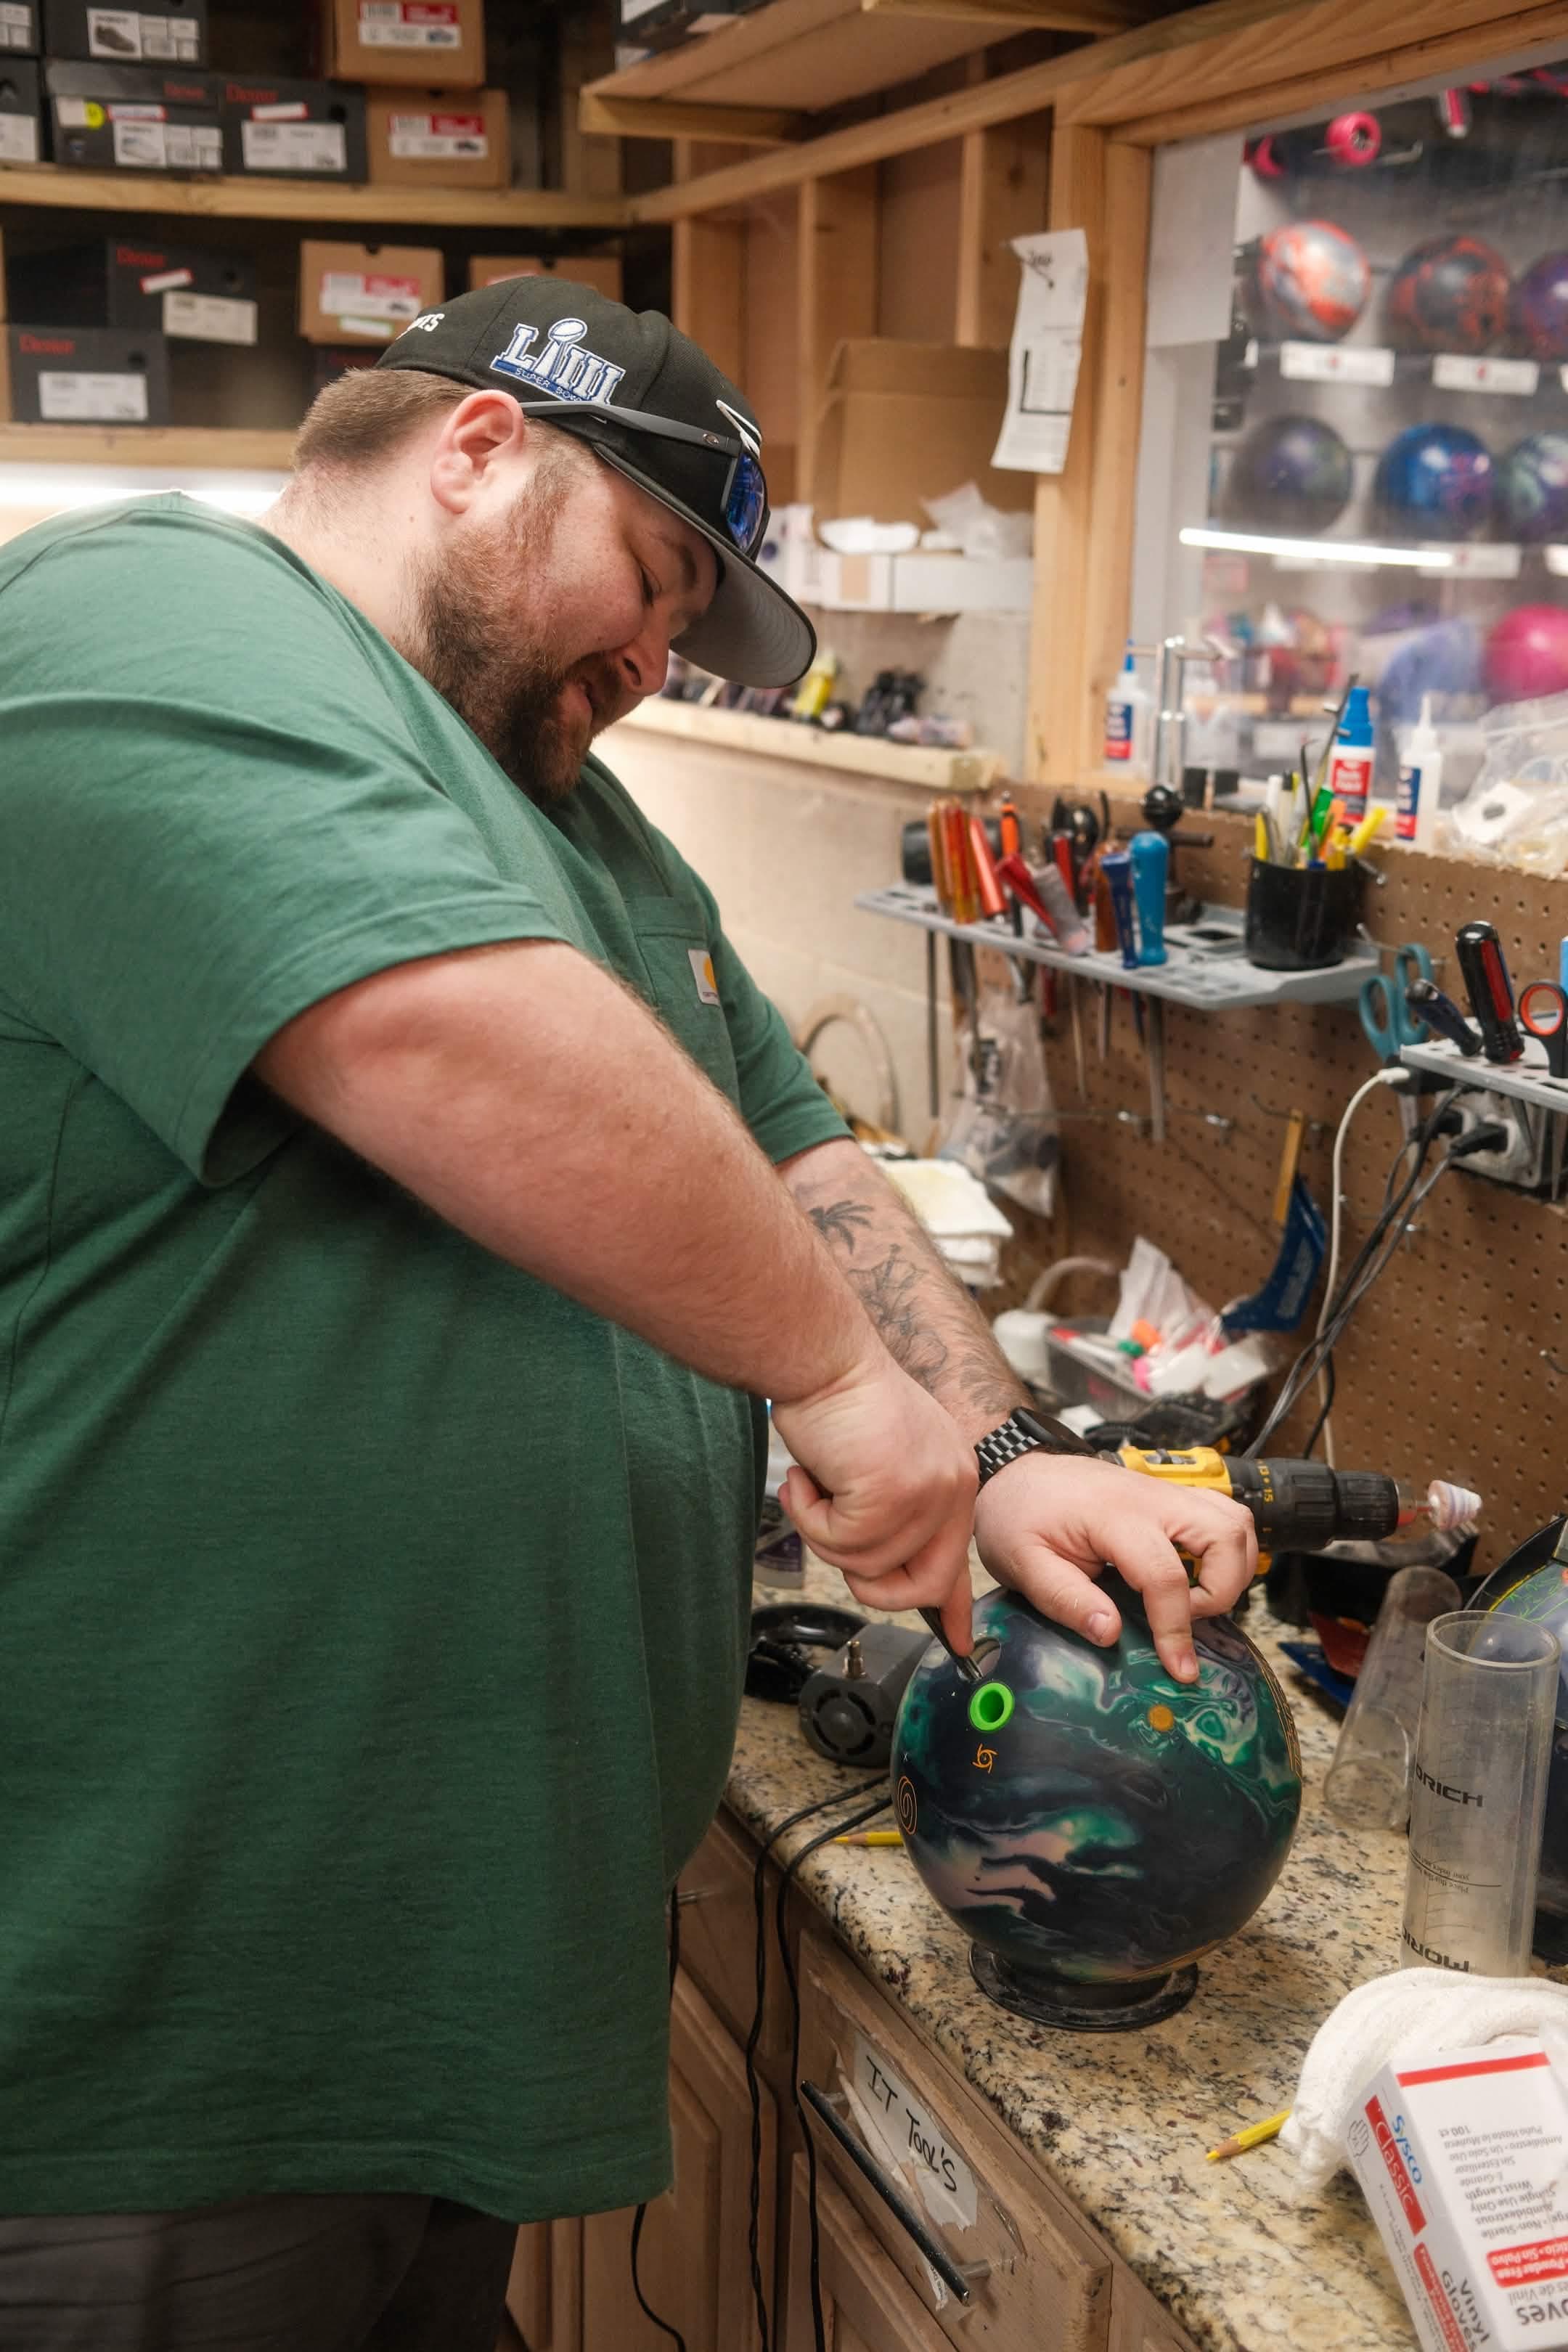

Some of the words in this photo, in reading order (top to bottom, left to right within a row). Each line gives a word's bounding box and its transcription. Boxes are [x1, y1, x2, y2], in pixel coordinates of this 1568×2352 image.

[515, 367, 550, 388] SUPER
[1263, 1487, 1274, 1503] 15
[1451, 2126, 1471, 2137] 100
[1376, 2120, 1414, 2211] Classic
[1465, 2186, 1503, 2200] Length
[1505, 2180, 1534, 2192] Wrist
[1471, 2202, 1497, 2213] Only
[1498, 2197, 1518, 2207] Use
[1524, 2258, 1565, 2274] Powder
[1496, 2268, 1524, 2279] Free
[1461, 2277, 1490, 2343] Vinyl
